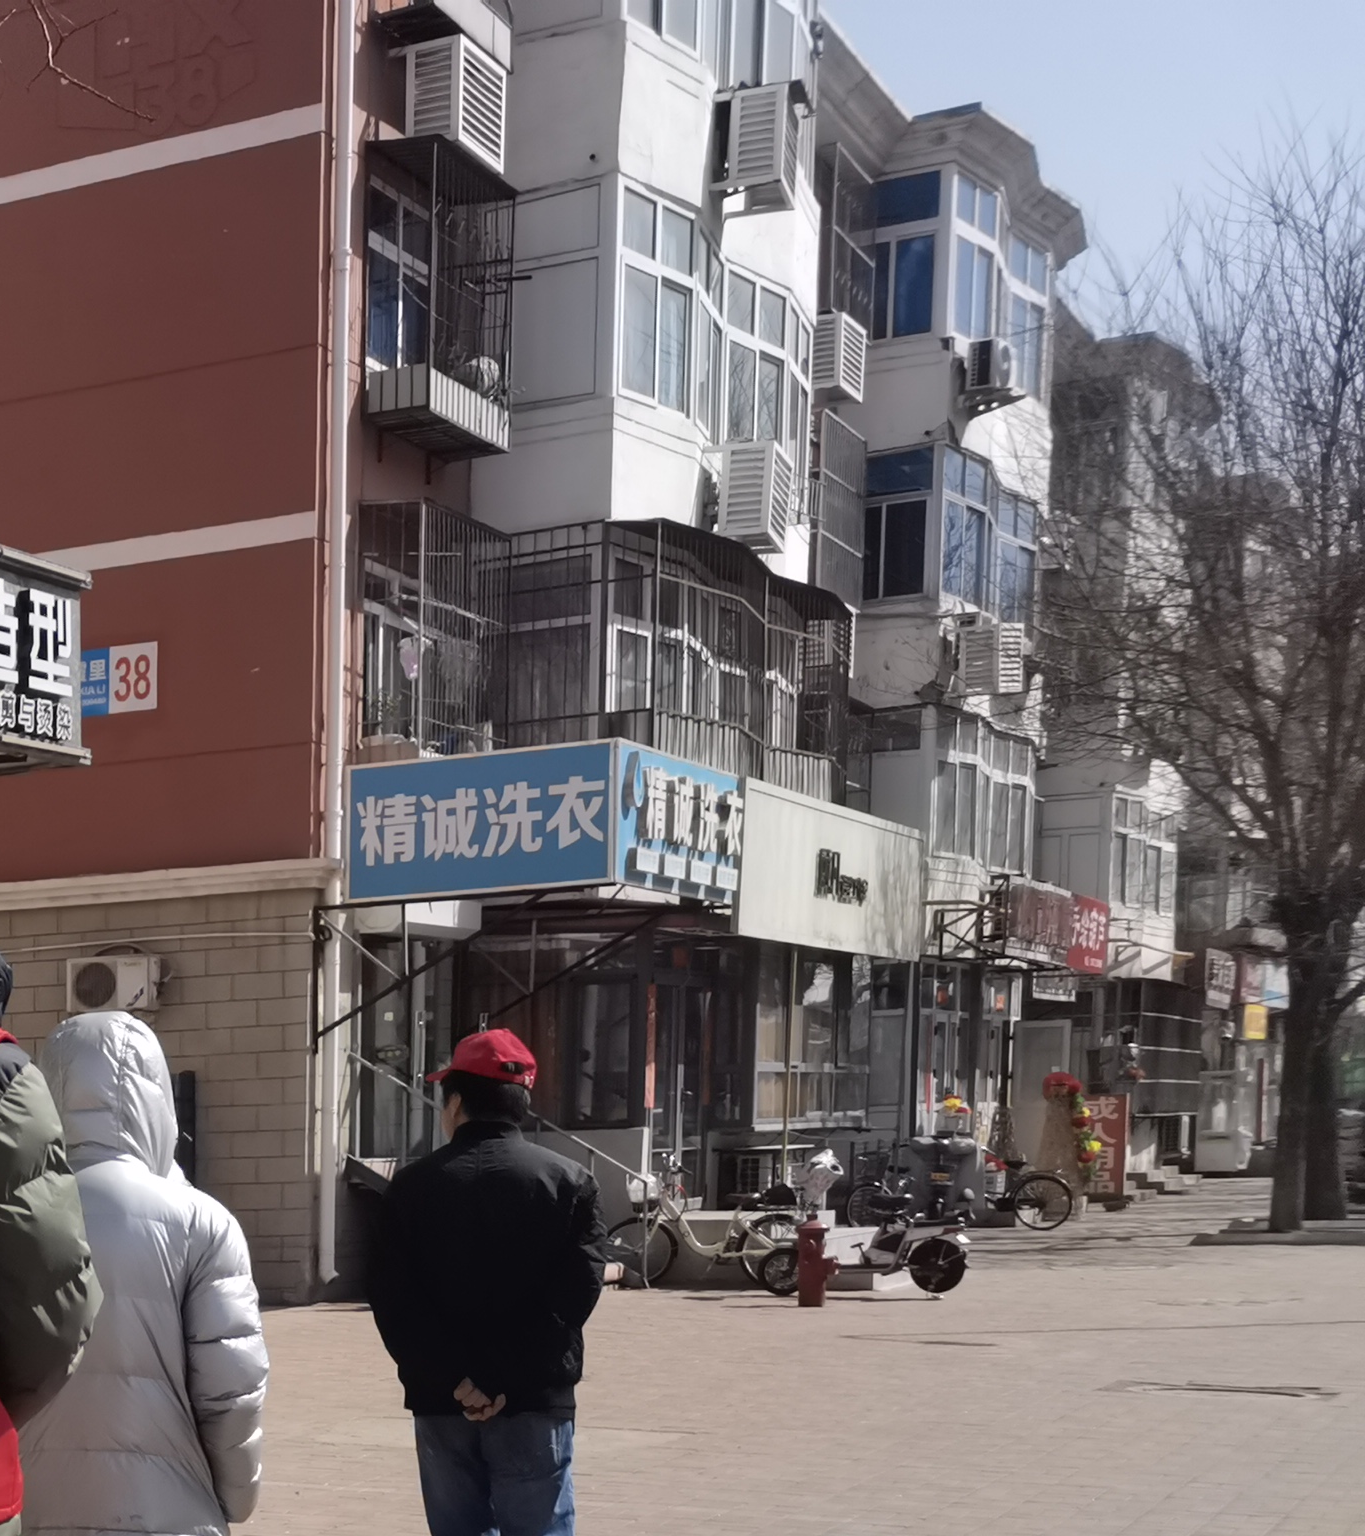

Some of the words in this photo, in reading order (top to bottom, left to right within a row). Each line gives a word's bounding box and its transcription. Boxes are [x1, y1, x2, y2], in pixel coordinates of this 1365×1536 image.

[114, 654, 151, 702] 38
[357, 775, 605, 866] 精诚洗衣
[642, 766, 743, 856] 精诚洗衣
